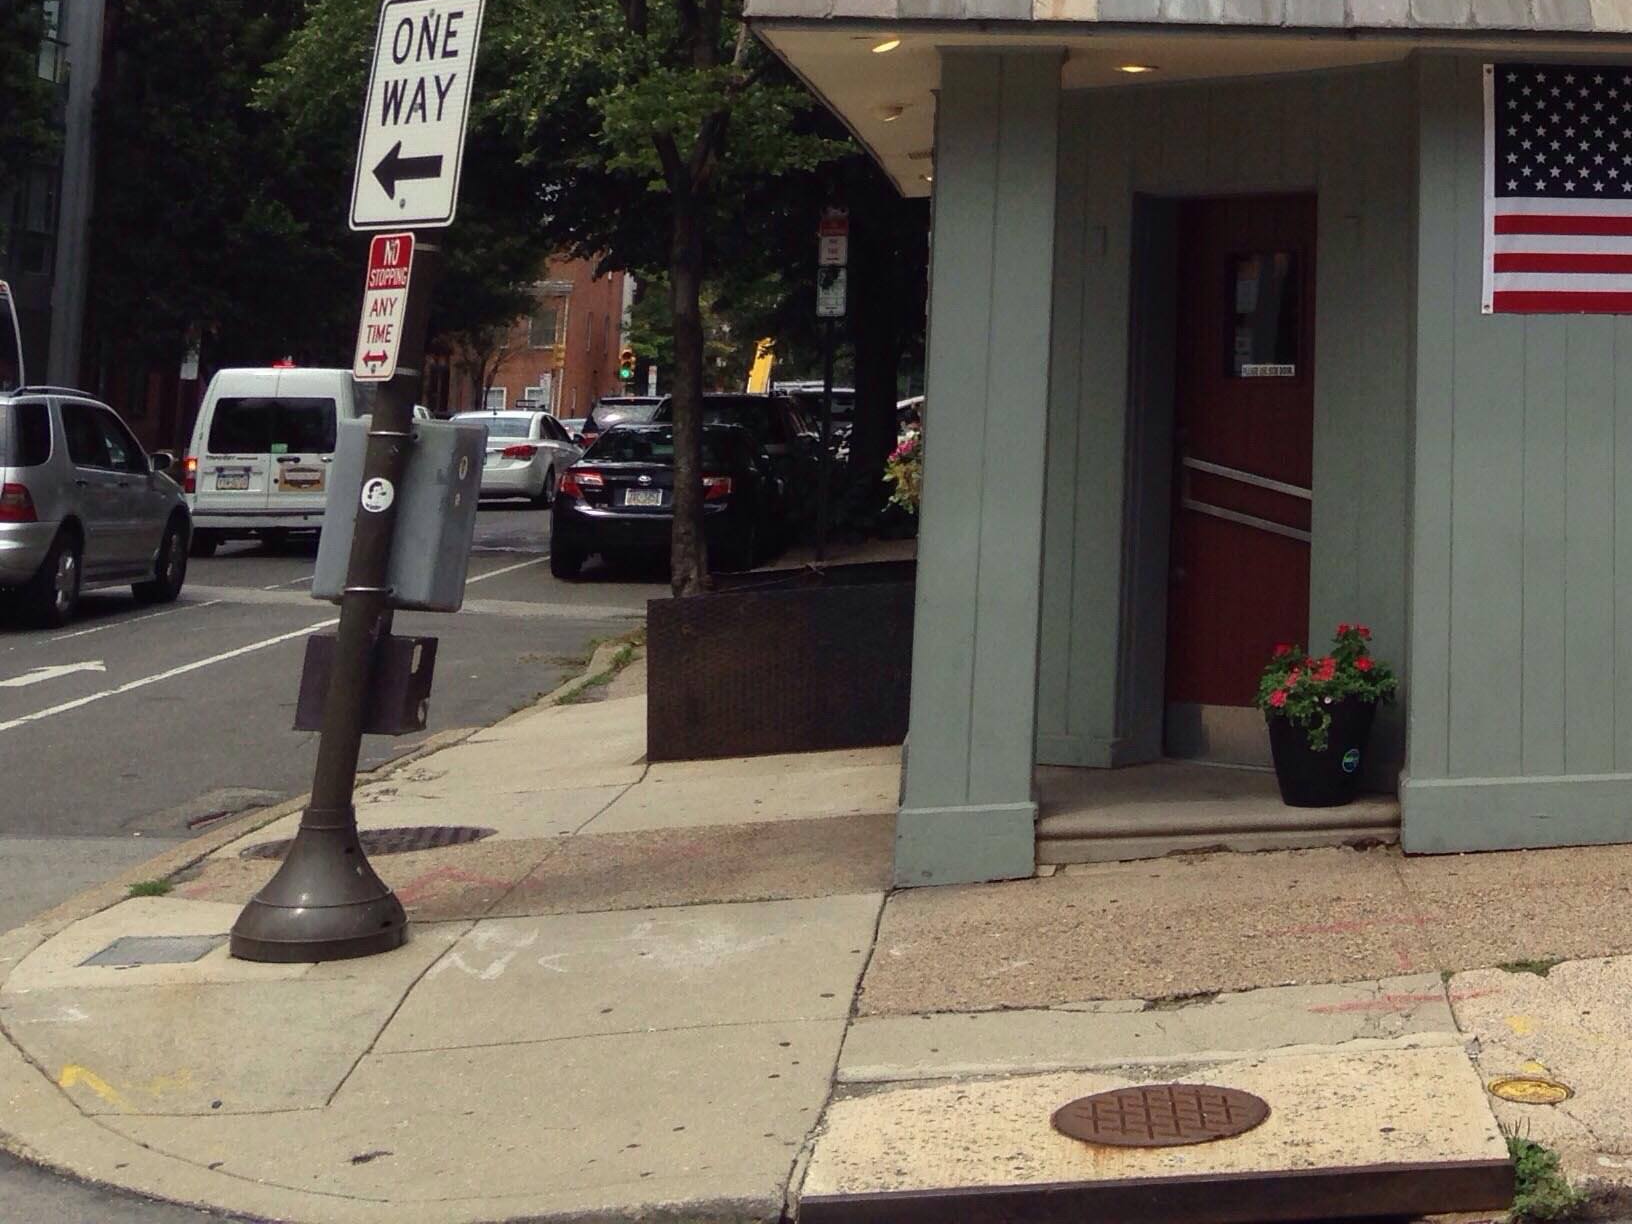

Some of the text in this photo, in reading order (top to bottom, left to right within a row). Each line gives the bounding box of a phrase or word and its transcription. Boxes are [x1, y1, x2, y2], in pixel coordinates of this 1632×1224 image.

[392, 10, 464, 64] ONE
[381, 73, 456, 126] WAY
[383, 239, 401, 266] NO
[369, 267, 408, 287] STOPPING
[370, 297, 398, 317] ANY
[367, 324, 393, 344] TIME
